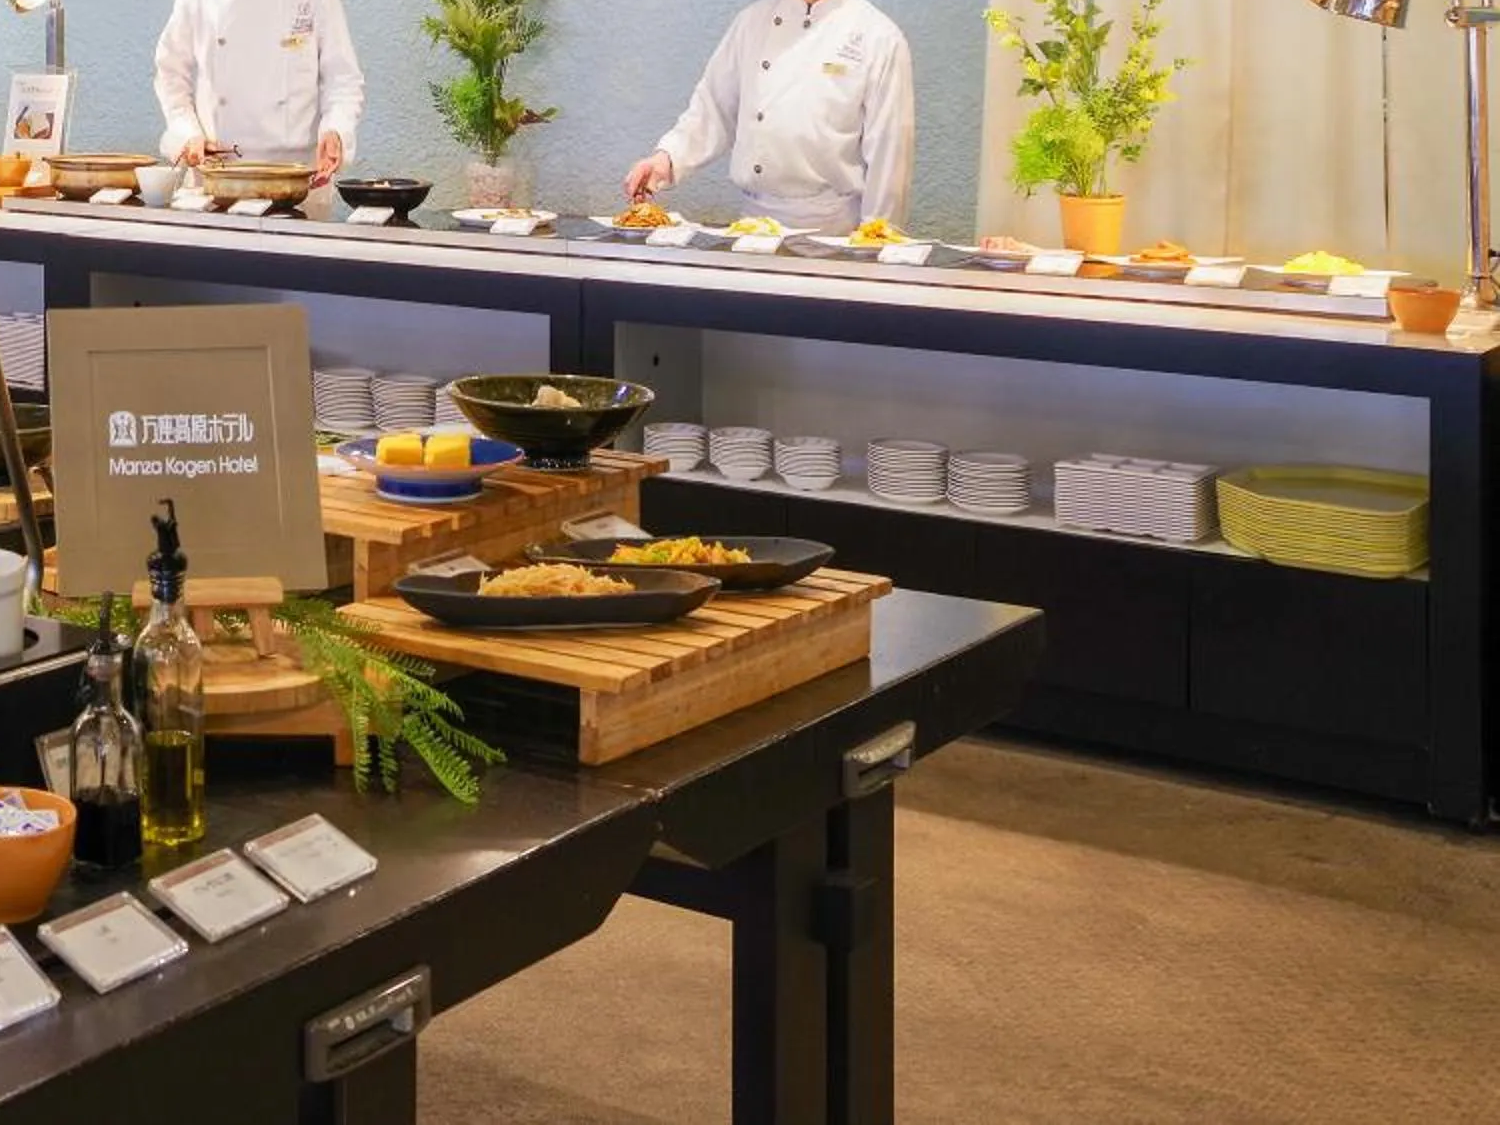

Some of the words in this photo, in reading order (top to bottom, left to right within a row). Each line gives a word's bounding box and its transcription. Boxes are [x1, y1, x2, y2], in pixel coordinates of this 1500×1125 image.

[141, 413, 255, 444] 万座高原ホテル
[109, 458, 163, 476] Manza
[165, 456, 217, 479] Kogen
[219, 454, 258, 474] Hotel
